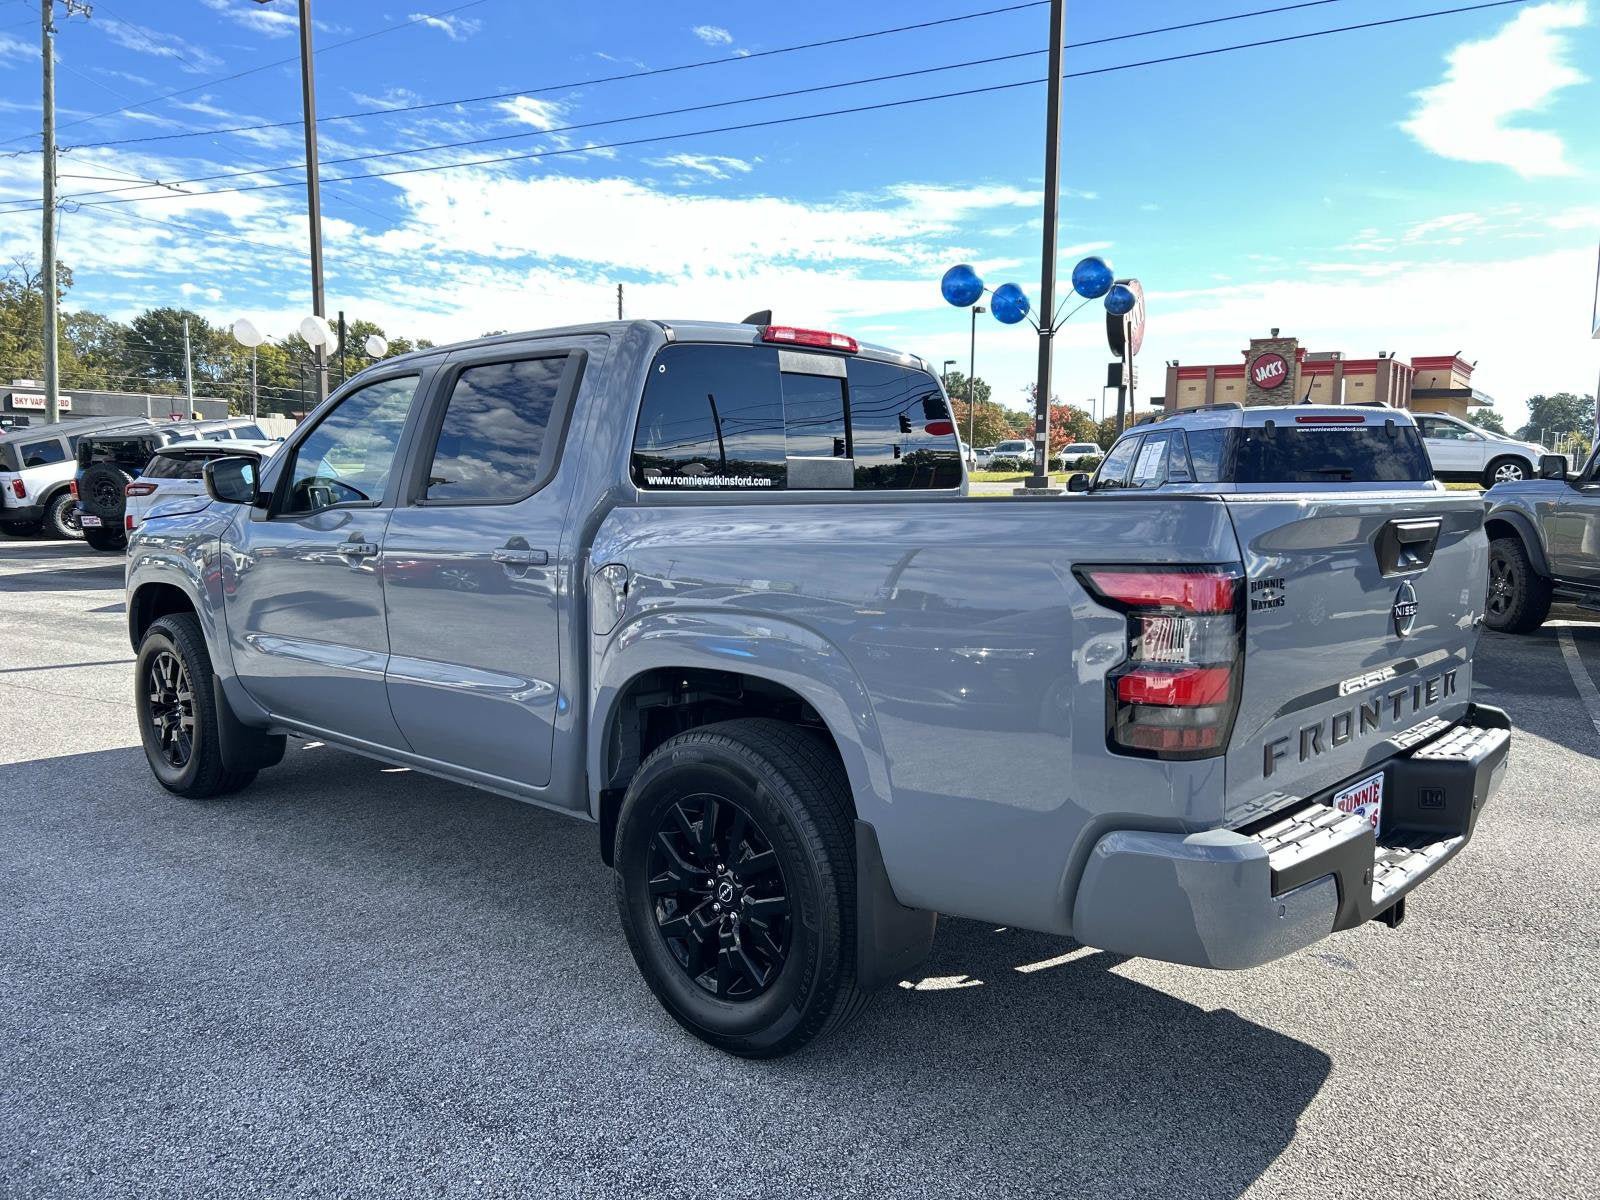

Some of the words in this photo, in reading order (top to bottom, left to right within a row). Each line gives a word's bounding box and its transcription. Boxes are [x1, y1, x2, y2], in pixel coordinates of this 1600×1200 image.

[14, 396, 28, 405] SKY
[647, 475, 771, 486] www.ronniewatkinsford.com
[1250, 578, 1285, 593] RONNIE
[1250, 595, 1285, 611] WATKINS
[1395, 605, 1417, 616] NISS
[1263, 667, 1458, 779] FRONTIER
[1337, 783, 1380, 813] RONNIE
